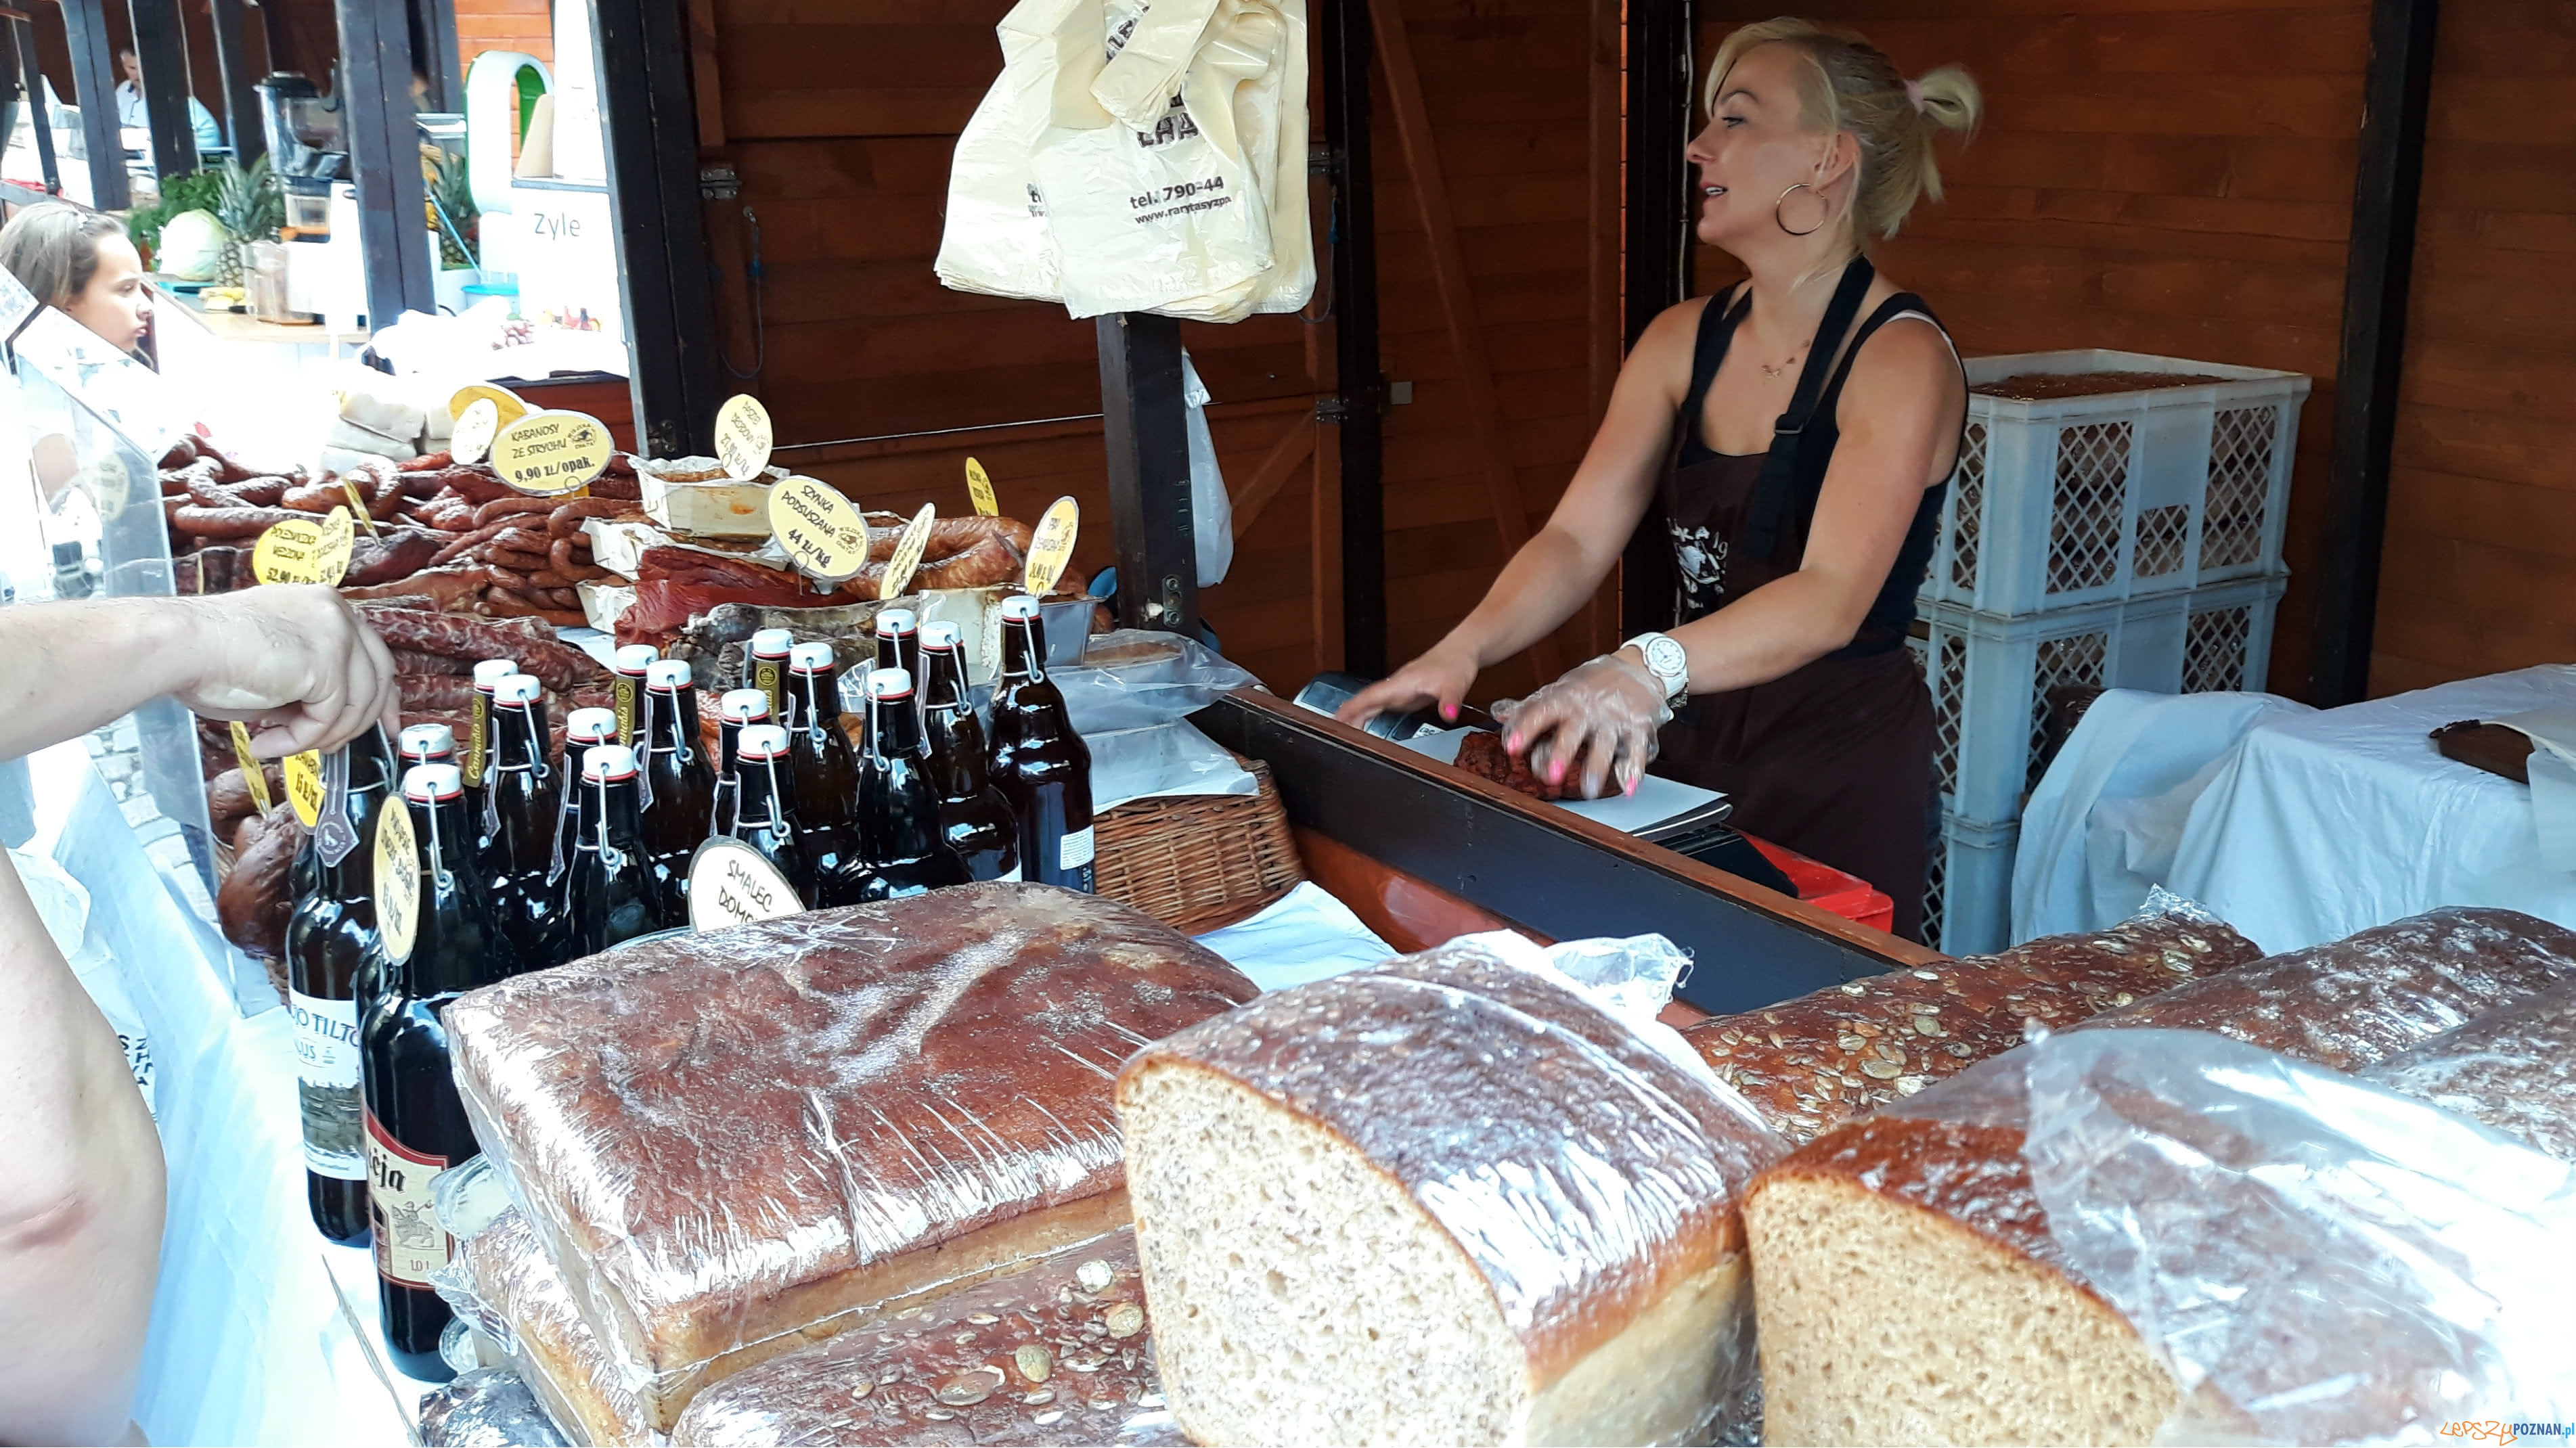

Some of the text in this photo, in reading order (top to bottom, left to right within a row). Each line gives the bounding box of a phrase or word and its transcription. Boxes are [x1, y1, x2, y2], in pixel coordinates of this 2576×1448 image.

[1130, 191, 1158, 209] tel.
[511, 424, 560, 442] KABANOSY
[512, 438, 567, 459] ZE STRYCHU
[515, 466, 541, 482] 9,90
[801, 484, 835, 514] SZYNKA
[781, 490, 836, 538] PODSUSZANA
[788, 528, 803, 544] 44
[727, 859, 773, 913] SMALEC
